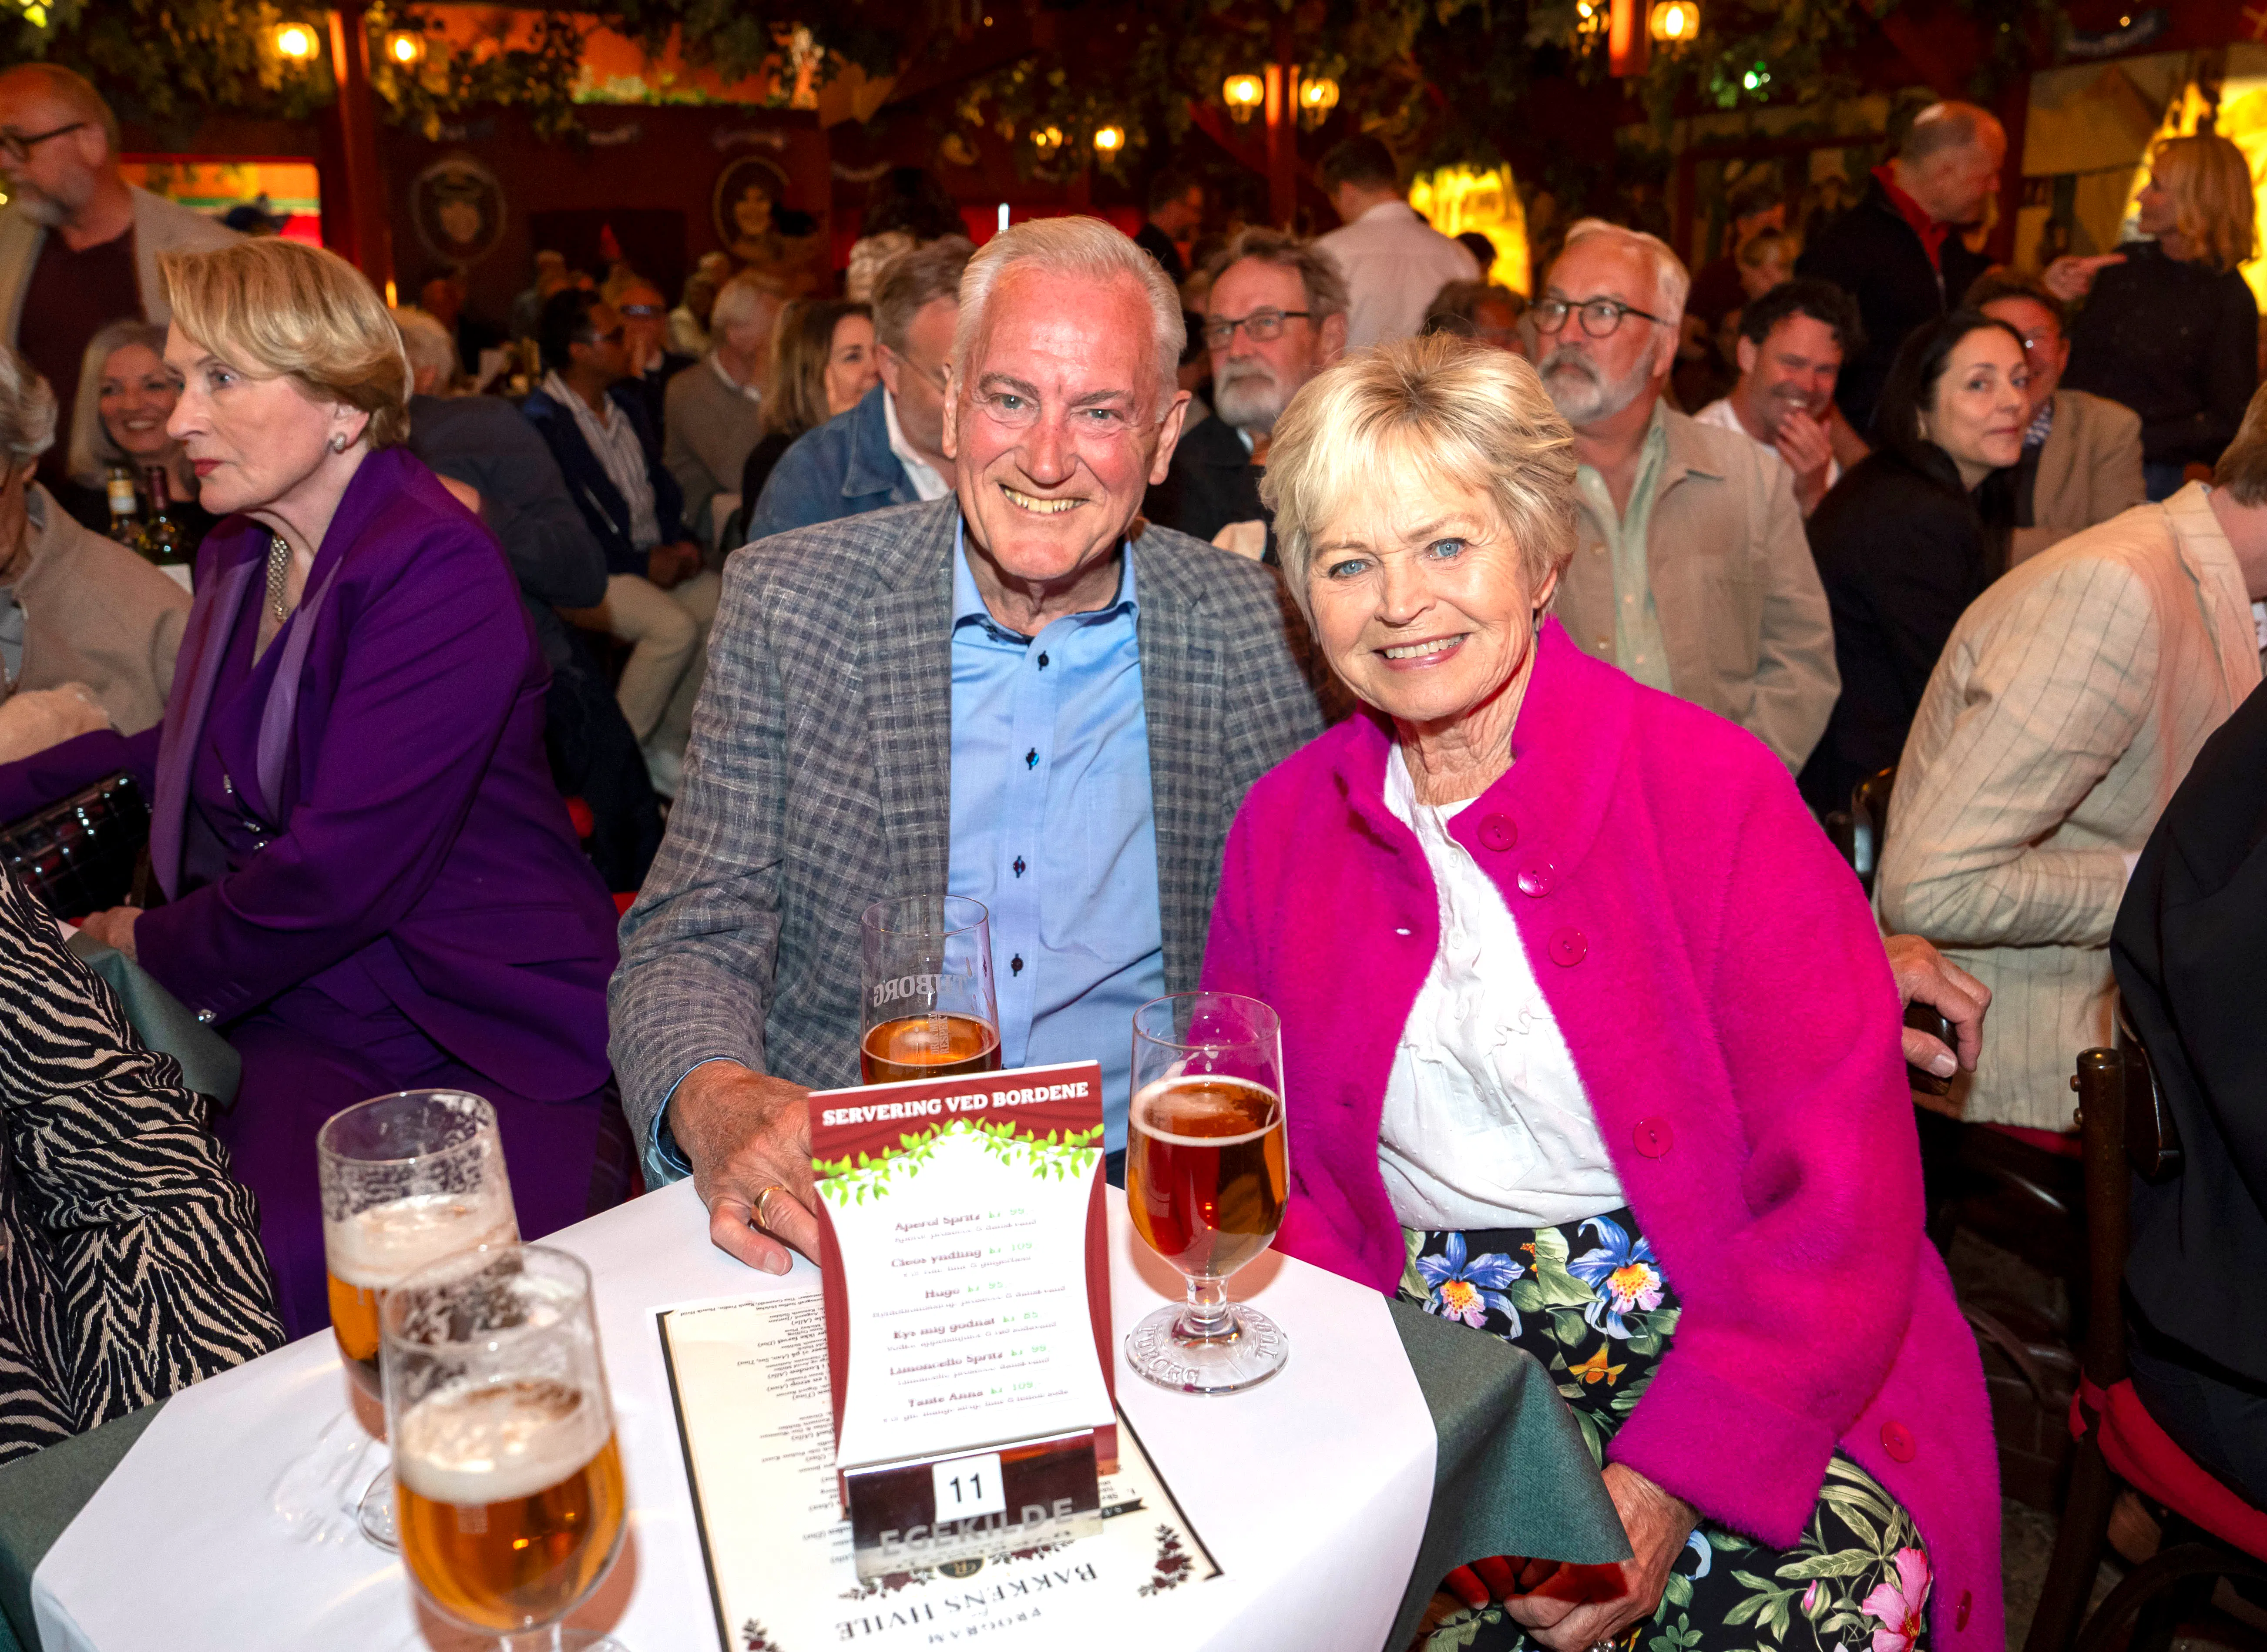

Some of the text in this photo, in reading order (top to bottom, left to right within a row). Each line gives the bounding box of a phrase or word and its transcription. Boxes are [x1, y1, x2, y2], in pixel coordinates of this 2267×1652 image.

[822, 1082, 1089, 1126] SERVERING VED BORDENE
[895, 1217, 938, 1232] Aperol
[943, 1213, 981, 1226] Spritz
[925, 1288, 960, 1299] Hugo
[920, 1325, 946, 1338] mig
[949, 1317, 995, 1333] godnat
[890, 1357, 962, 1376] Limoncello
[966, 1351, 1003, 1365] Spritz
[908, 1394, 945, 1407] Tante
[949, 1389, 984, 1401] Anna
[950, 1472, 982, 1504] 11
[879, 1497, 1074, 1558] EGEKILDE
[944, 1562, 1099, 1612] BAKKENS
[927, 1607, 1042, 1645] PROGRAM
